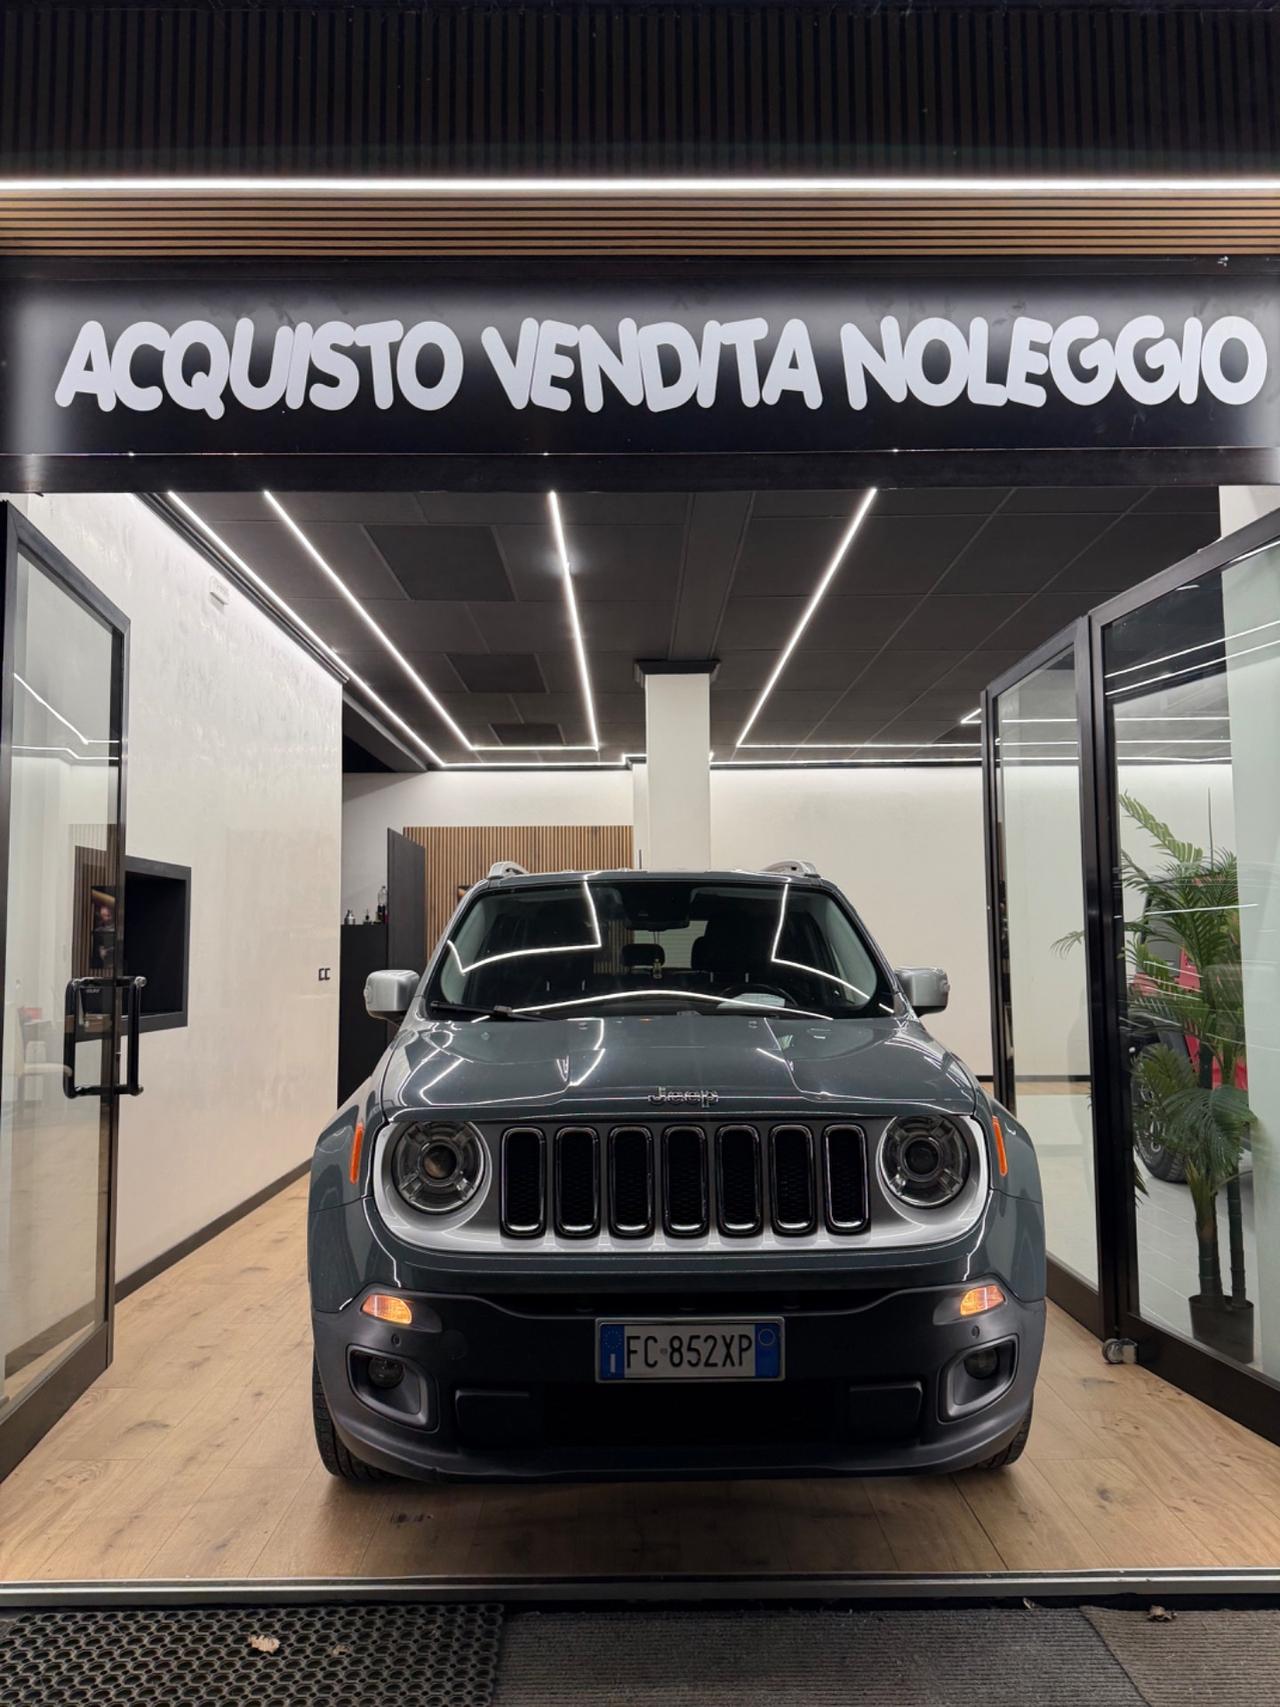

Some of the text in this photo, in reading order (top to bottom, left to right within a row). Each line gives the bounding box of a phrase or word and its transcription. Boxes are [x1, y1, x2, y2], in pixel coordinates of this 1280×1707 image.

[54, 315, 1268, 419] ACQUISTO VENDITA NOLEGGIO
[648, 1086, 719, 1108] Jeep
